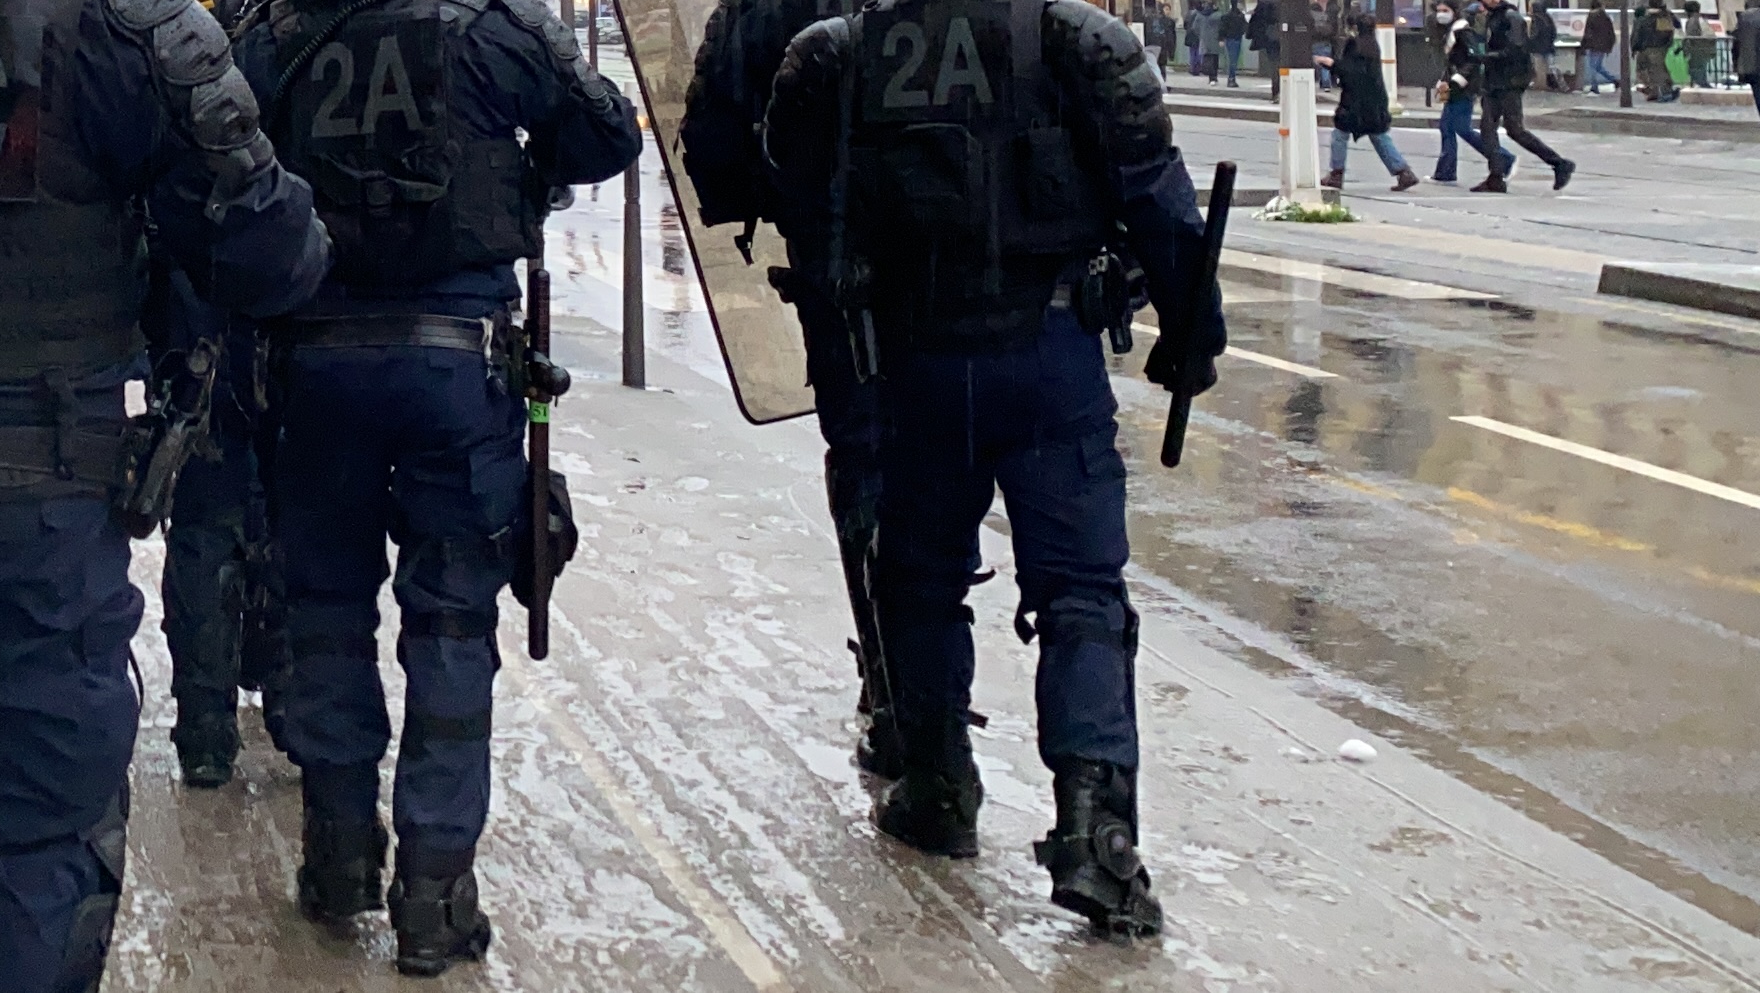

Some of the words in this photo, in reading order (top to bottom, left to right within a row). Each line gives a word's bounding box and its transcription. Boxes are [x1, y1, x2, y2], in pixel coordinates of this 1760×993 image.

[311, 34, 424, 138] 2A
[883, 17, 995, 108] 2A
[532, 405, 547, 417] 51
